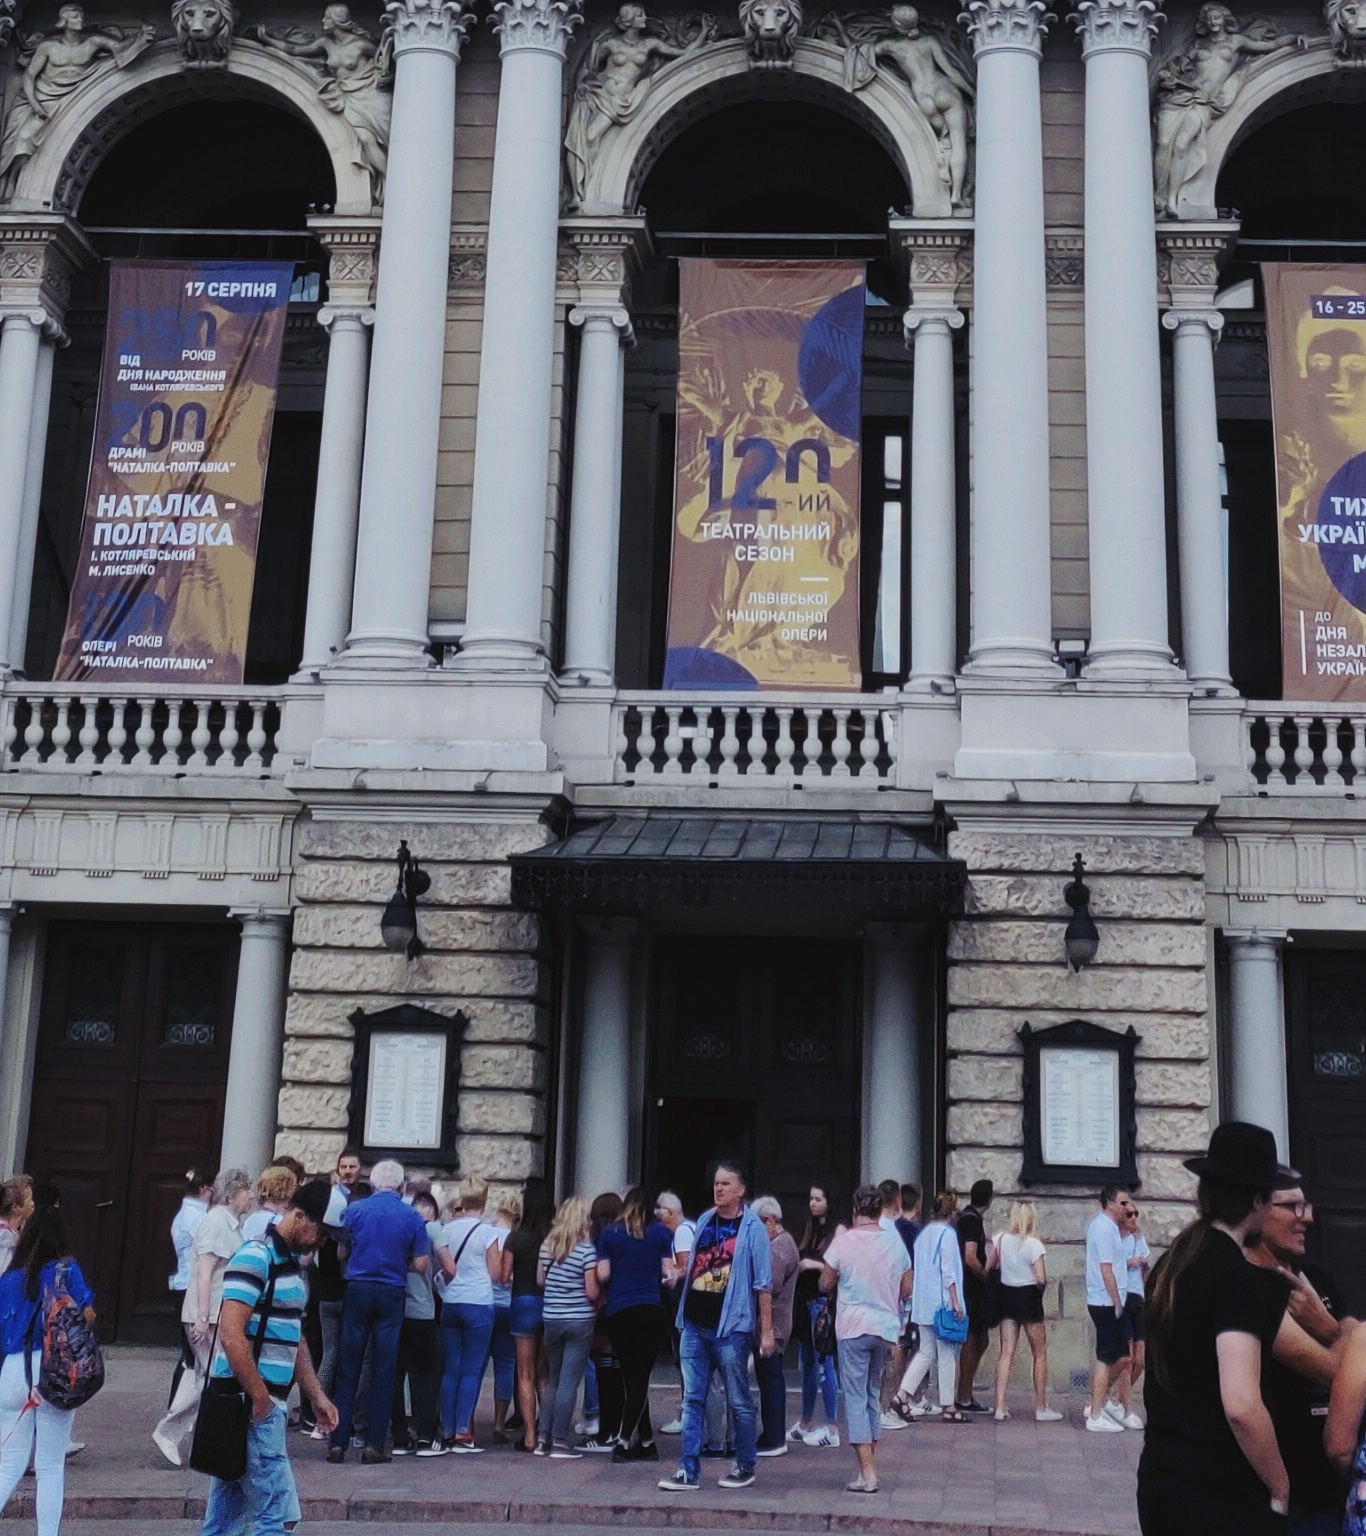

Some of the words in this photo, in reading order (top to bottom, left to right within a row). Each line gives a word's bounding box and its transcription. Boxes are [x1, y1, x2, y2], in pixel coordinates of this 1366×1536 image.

[185, 282, 205, 297] 17
[207, 282, 277, 298] СЕРПНЯ
[1315, 300, 1334, 314] 16
[1347, 301, 1366, 314] 25
[119, 354, 141, 368] ВІД
[181, 349, 217, 362] РОКІВ
[117, 369, 143, 382] ДНЯ
[145, 369, 226, 382] НАРОДЖЕННЯ
[129, 383, 154, 391] ІВАНА
[155, 383, 224, 392] КОТЛЯРЕВСЬКОГО
[106, 400, 207, 453] 200
[108, 447, 147, 459] ДРАМІ
[171, 441, 205, 453] РОКІВ
[96, 493, 219, 517] НАТАЛКА
[93, 521, 234, 546] ПОЛТАВКА
[700, 521, 830, 541] ТЕАТРАЛЬНИЙ
[90, 550, 98, 562] І.
[100, 548, 196, 562] КОТЛЯРЕВСЬКИЙ
[735, 545, 795, 562] СЕЗОН
[88, 565, 102, 577] М.
[102, 564, 156, 576] ЛИСЕНКО
[747, 590, 829, 606] ЛЬВІВСЬКОЇ
[726, 608, 828, 624] НАЦІОНАЛЬНОЇ
[1315, 611, 1332, 623] ДО
[127, 634, 164, 648] РОКІВ
[781, 628, 827, 642] ОПЕРИ
[1315, 626, 1347, 642] ДНЯ
[81, 640, 117, 653] ОПЕРІ
